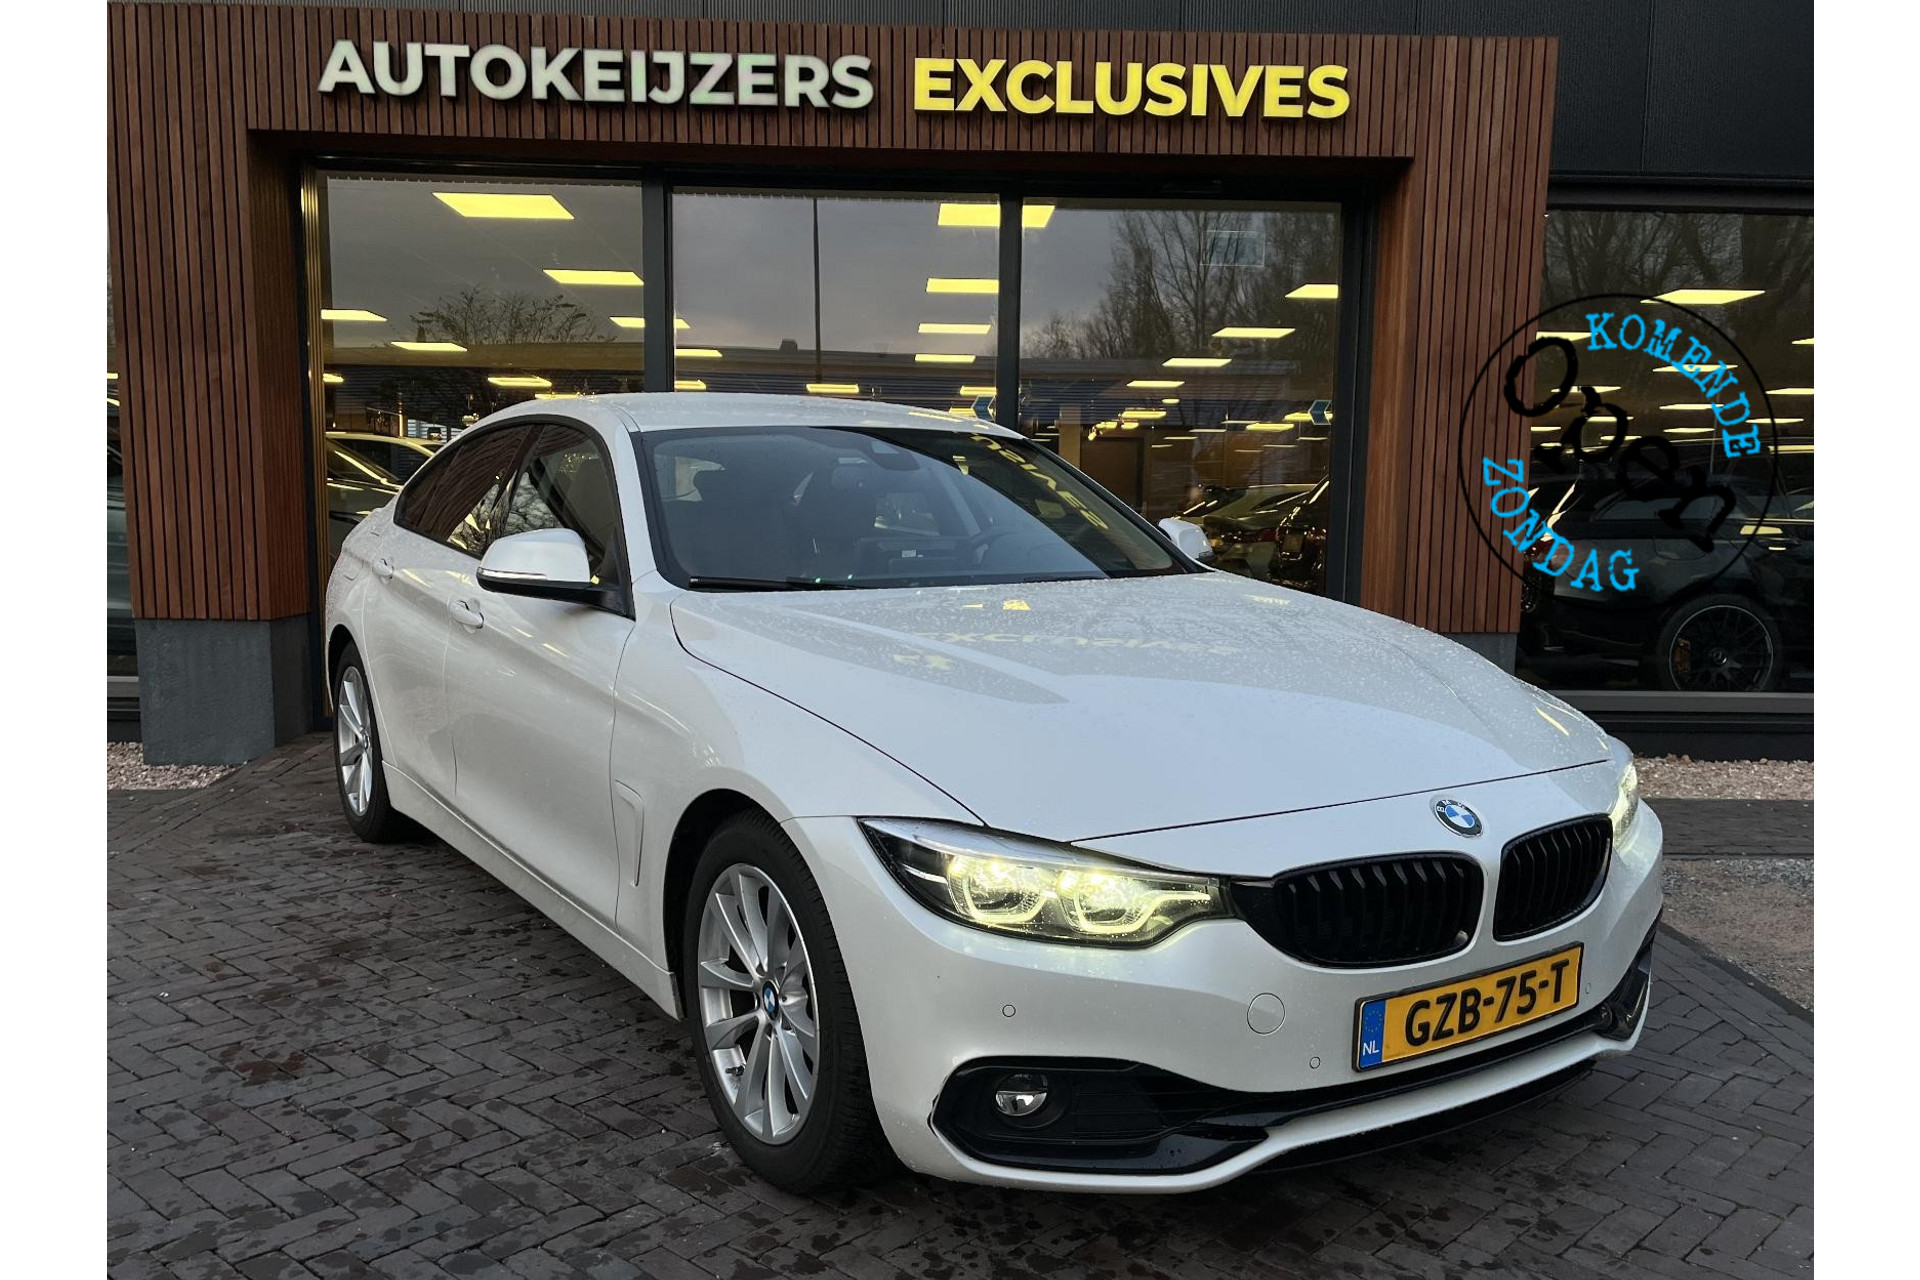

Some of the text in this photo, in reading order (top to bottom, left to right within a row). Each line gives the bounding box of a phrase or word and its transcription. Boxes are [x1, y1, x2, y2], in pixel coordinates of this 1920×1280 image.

[318, 39, 1351, 119] AUTOKEIJZERS EXCLUSIVES
[1405, 959, 1570, 1047] GZB-75-T
[1362, 1039, 1380, 1056] NL
